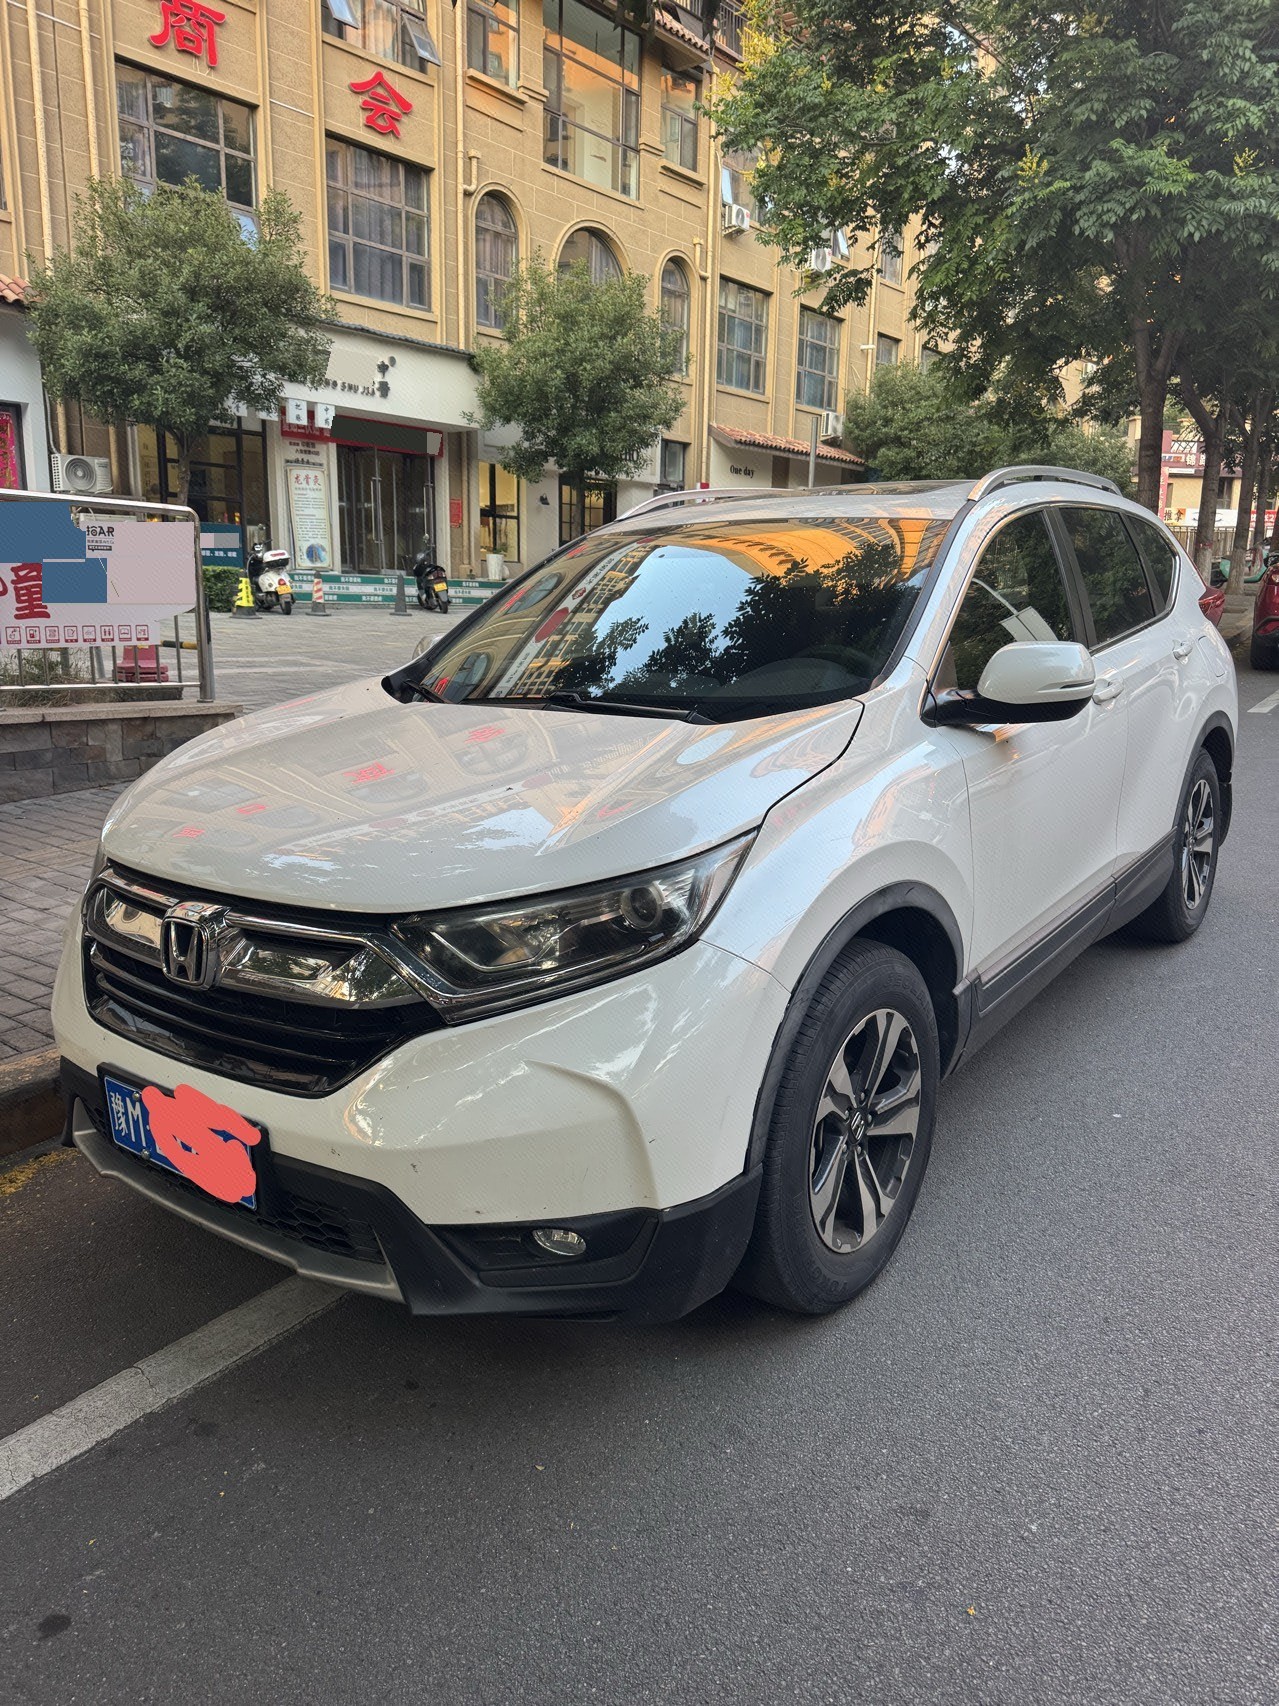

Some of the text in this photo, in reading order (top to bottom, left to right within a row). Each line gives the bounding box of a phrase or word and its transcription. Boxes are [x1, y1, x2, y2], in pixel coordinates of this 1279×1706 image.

[149, 0, 413, 138] 商 会
[729, 464, 755, 479] One day
